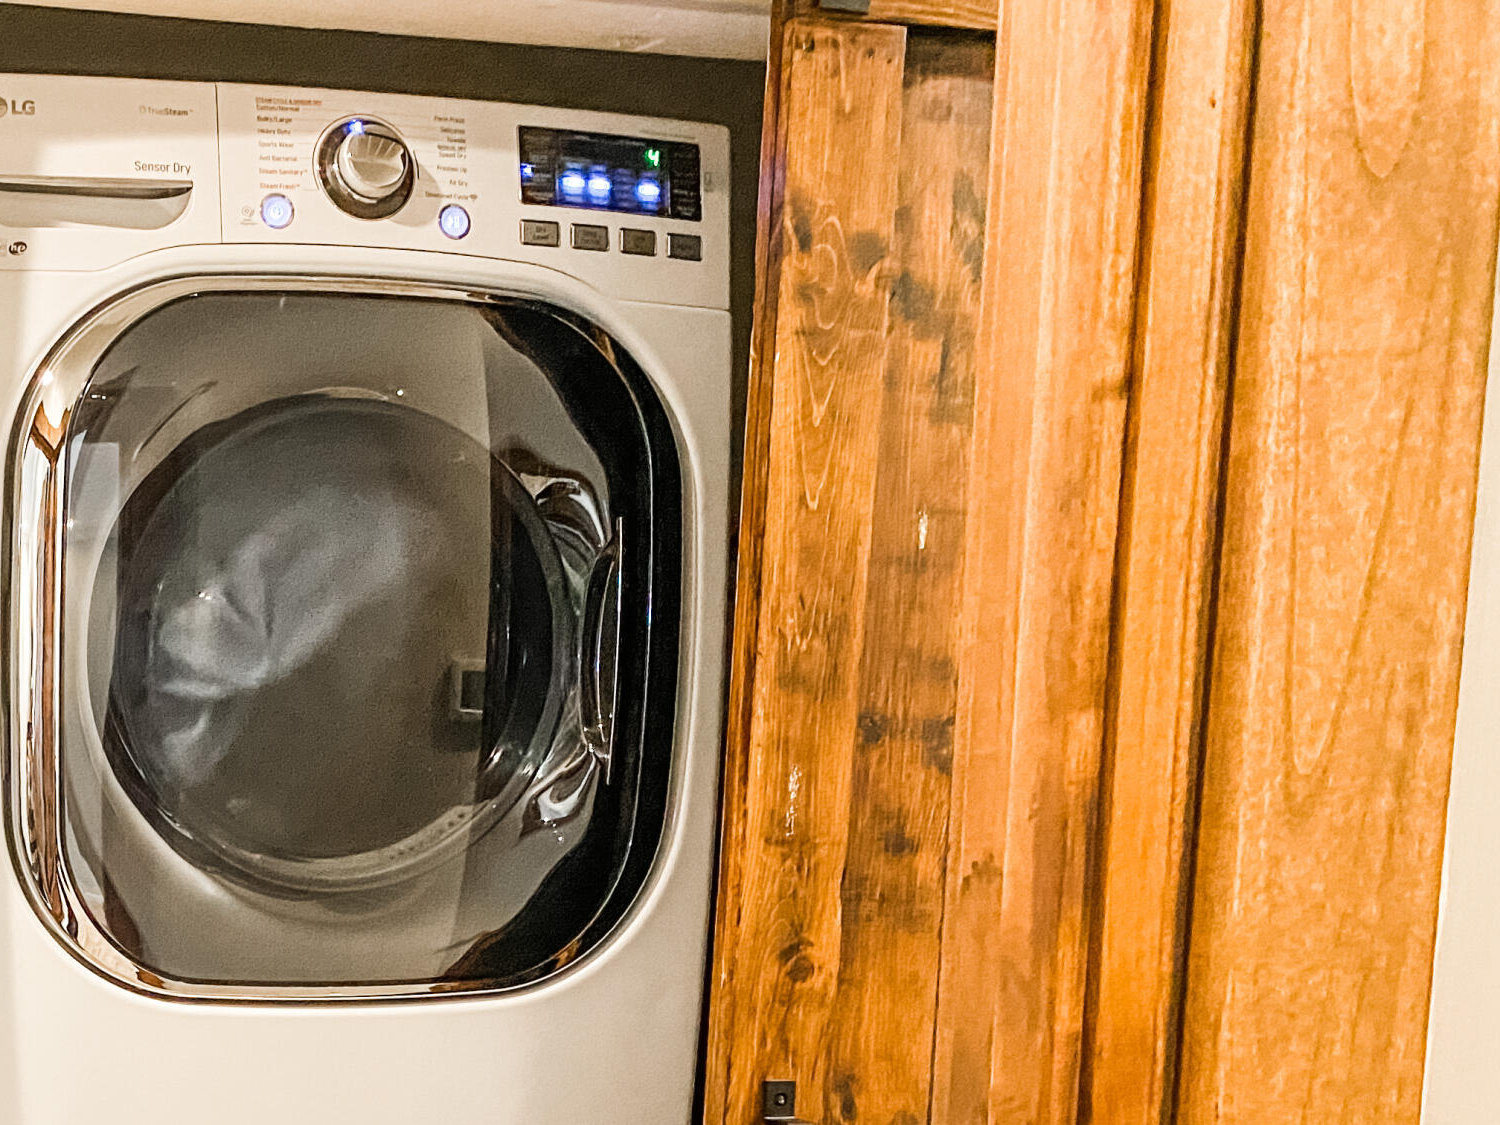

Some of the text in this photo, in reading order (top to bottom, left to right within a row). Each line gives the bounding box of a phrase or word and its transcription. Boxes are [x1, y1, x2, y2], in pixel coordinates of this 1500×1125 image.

[11, 100, 35, 115] LG
[647, 148, 661, 167] 4
[134, 160, 191, 174] Sensor Dry
